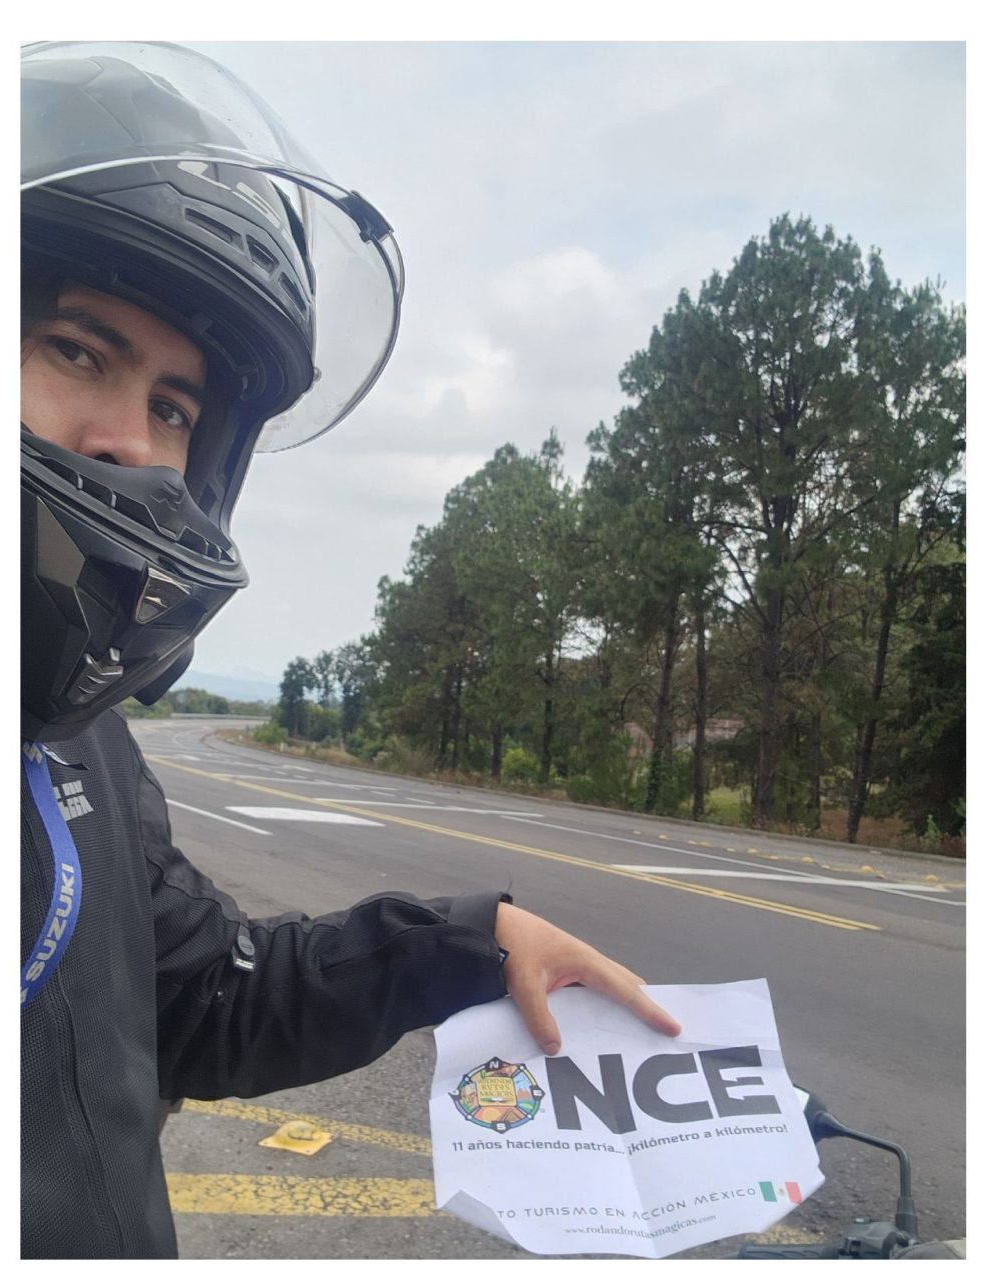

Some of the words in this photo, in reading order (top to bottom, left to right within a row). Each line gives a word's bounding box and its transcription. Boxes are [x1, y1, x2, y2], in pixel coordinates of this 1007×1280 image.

[25, 862, 75, 982] SUZUKI
[452, 1141, 463, 1151] 11
[468, 1139, 502, 1151] años
[506, 1139, 570, 1150] haciendo
[574, 1140, 625, 1155] patria...
[627, 1131, 700, 1156] ¡kilómetro
[703, 1130, 713, 1139] a
[715, 1123, 790, 1138] kilómetro!
[524, 1206, 598, 1217] TURISMO
[605, 1207, 626, 1217] EN
[564, 1214, 717, 1239] www.rodandorutasmagicas.com
